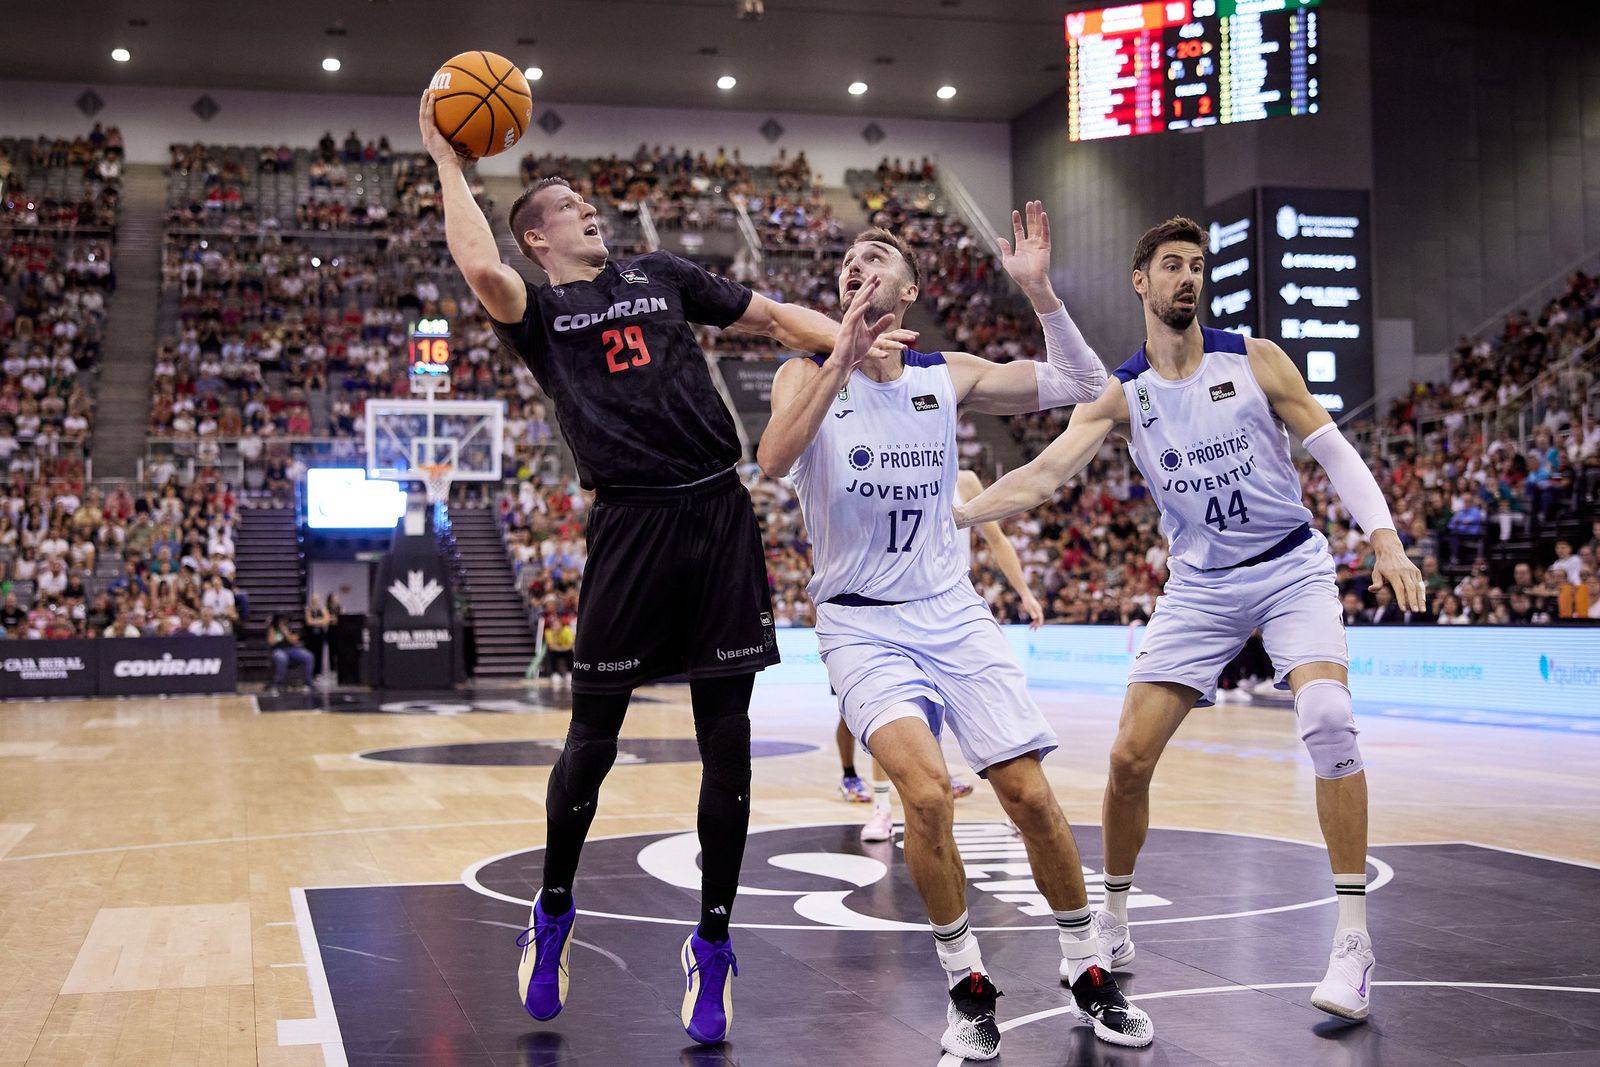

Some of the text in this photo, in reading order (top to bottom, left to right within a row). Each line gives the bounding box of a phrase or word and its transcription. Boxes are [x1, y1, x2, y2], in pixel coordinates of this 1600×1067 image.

[417, 339, 449, 364] 16
[601, 325, 652, 374] 29
[1187, 435, 1249, 466] PROBITAS
[846, 479, 942, 500] JOVENTU
[1162, 455, 1256, 493] JOVENTUT
[1204, 489, 1250, 532] 44
[886, 509, 922, 553] 17
